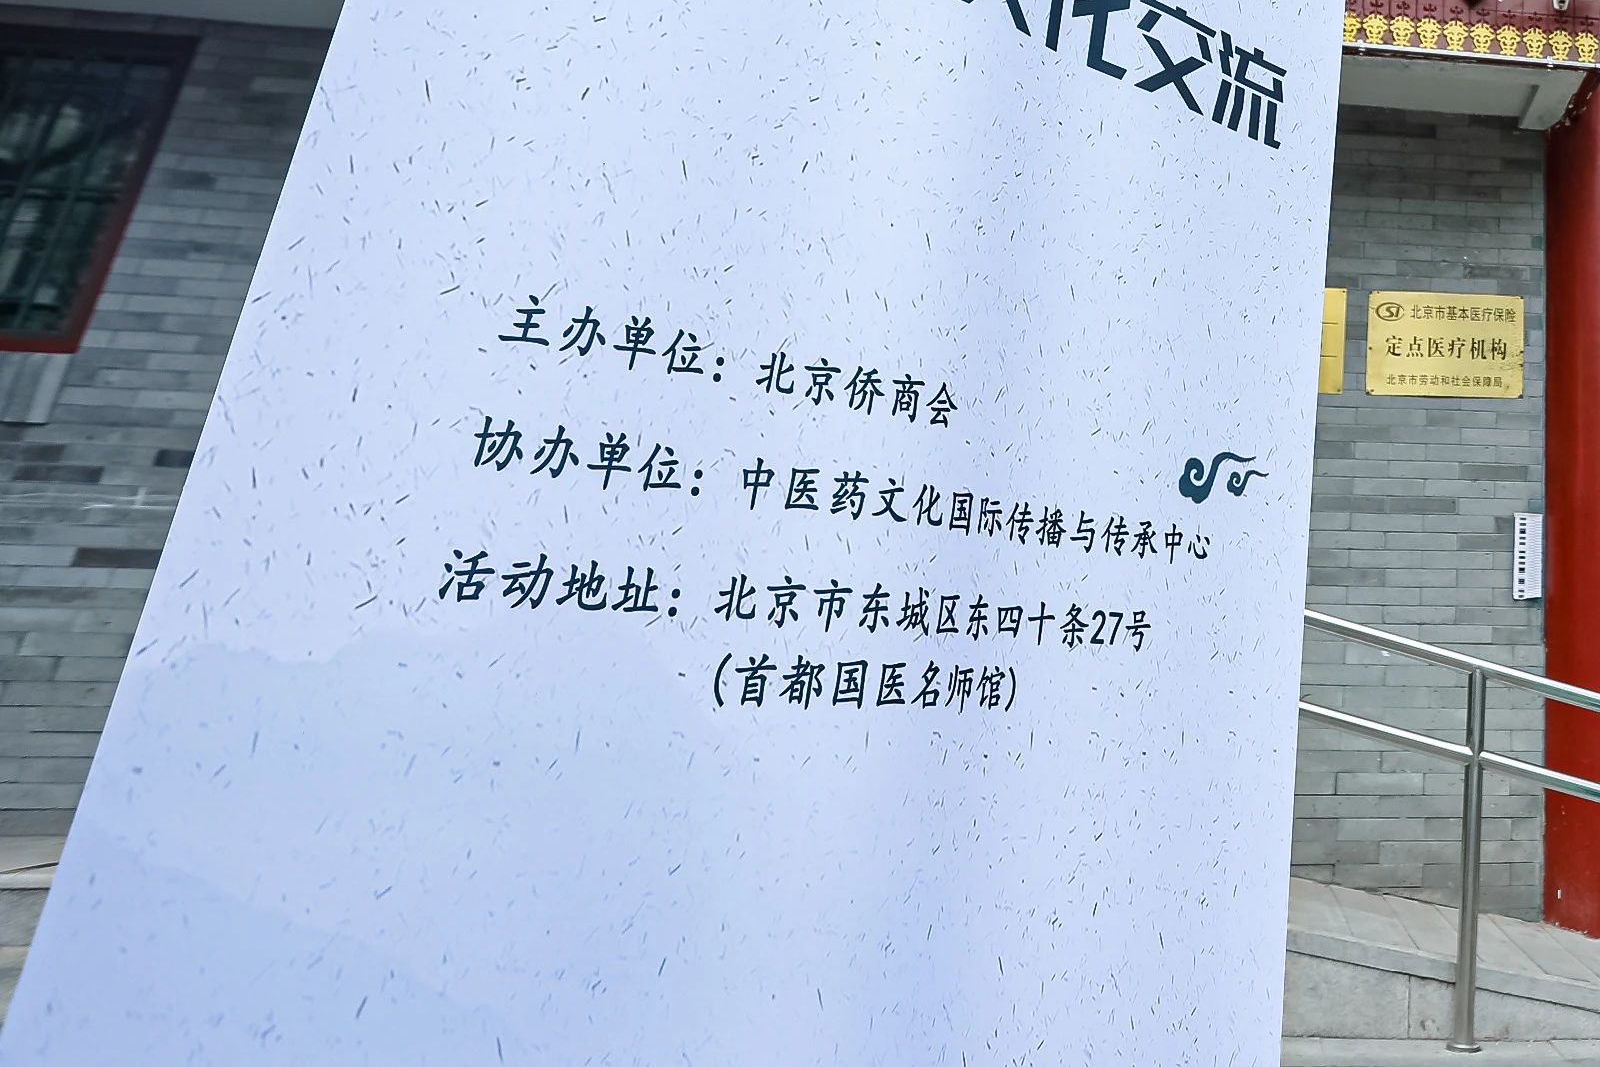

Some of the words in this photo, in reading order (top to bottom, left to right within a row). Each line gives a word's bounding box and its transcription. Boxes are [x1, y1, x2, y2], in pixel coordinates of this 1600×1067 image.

[1409, 304, 1517, 324] 北京市基本医疗保险
[1384, 335, 1508, 361] 定点医疗机构
[1386, 373, 1503, 388] 北京市劳动和社会保障局
